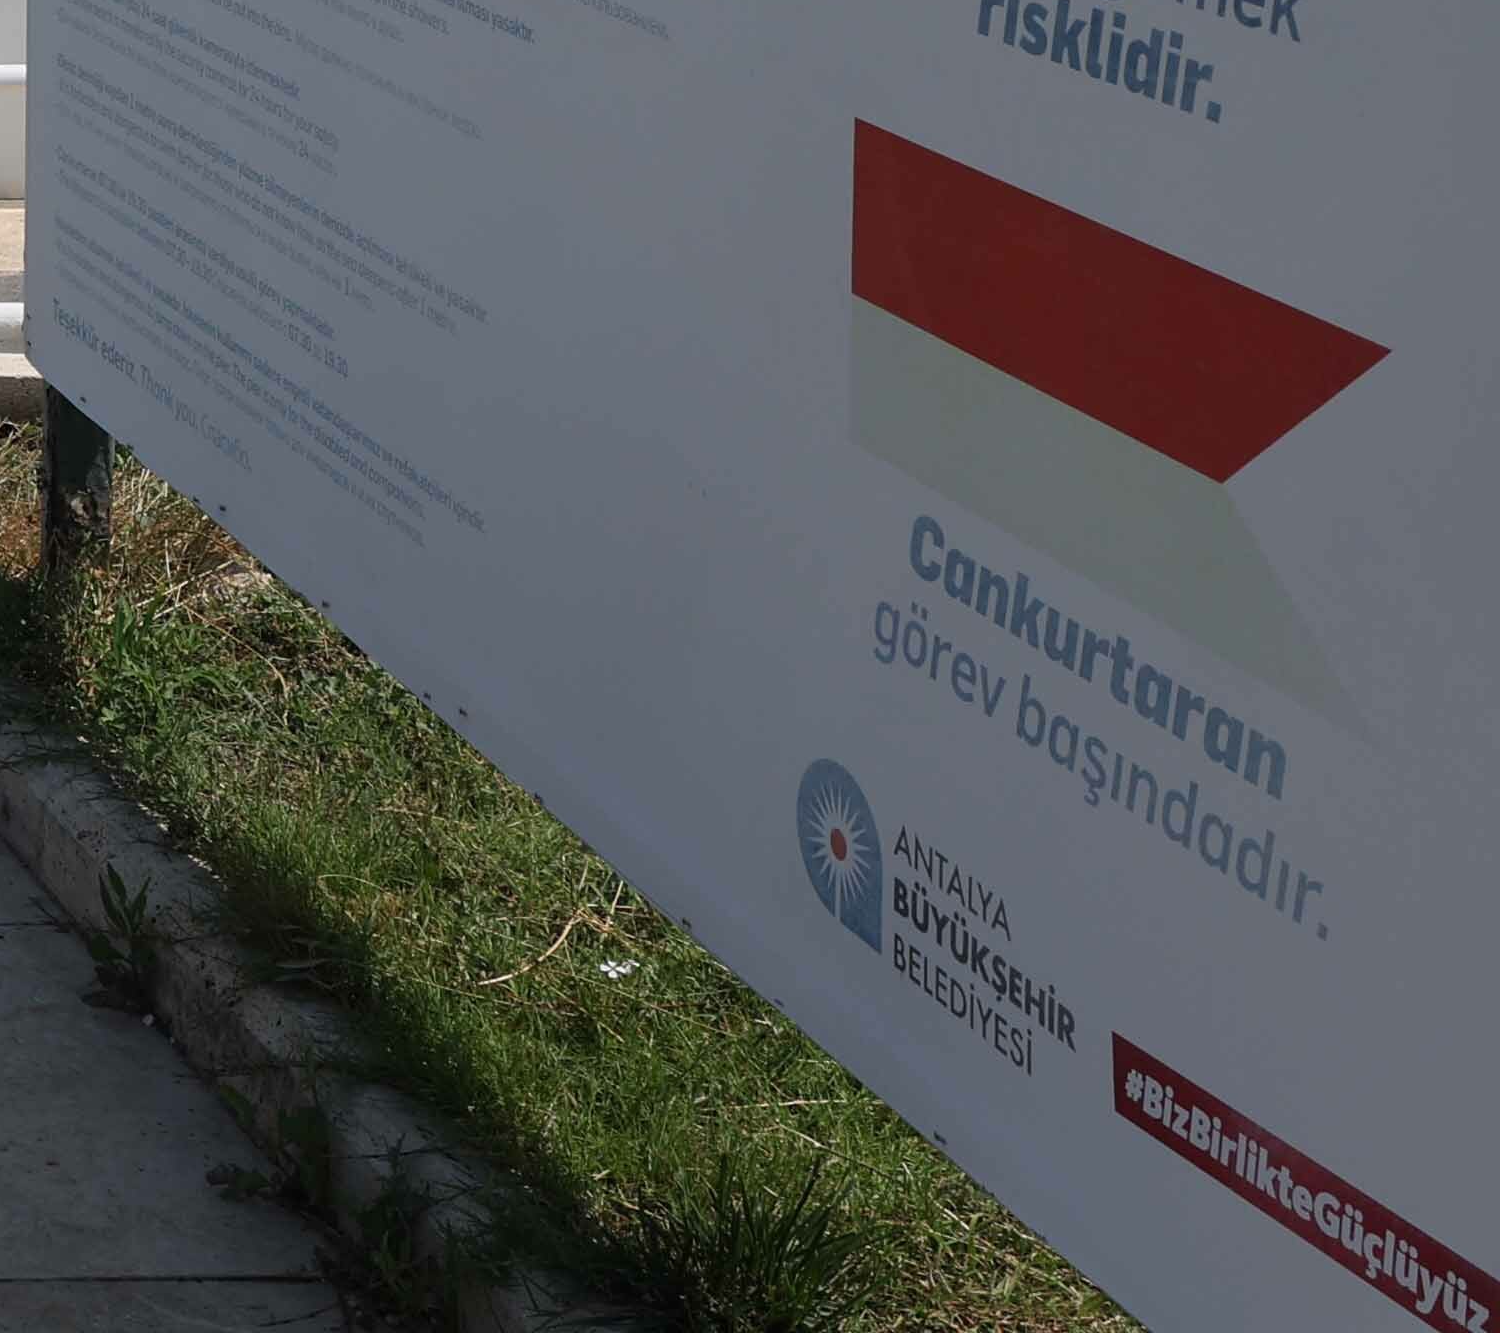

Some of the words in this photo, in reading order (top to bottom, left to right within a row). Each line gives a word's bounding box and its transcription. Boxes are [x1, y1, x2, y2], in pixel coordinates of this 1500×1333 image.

[910, 514, 1287, 801] Cankurtaran
[873, 598, 1008, 717] görev
[1015, 673, 1329, 942] başındadır.
[892, 877, 1078, 1053] BÜYÜKŞEHİR
[893, 824, 1012, 942] ANTALYA
[893, 933, 1034, 1077] BELEDİYESİ
[1124, 1068, 1490, 1333] #BizBirlikteGüçlüyüz
